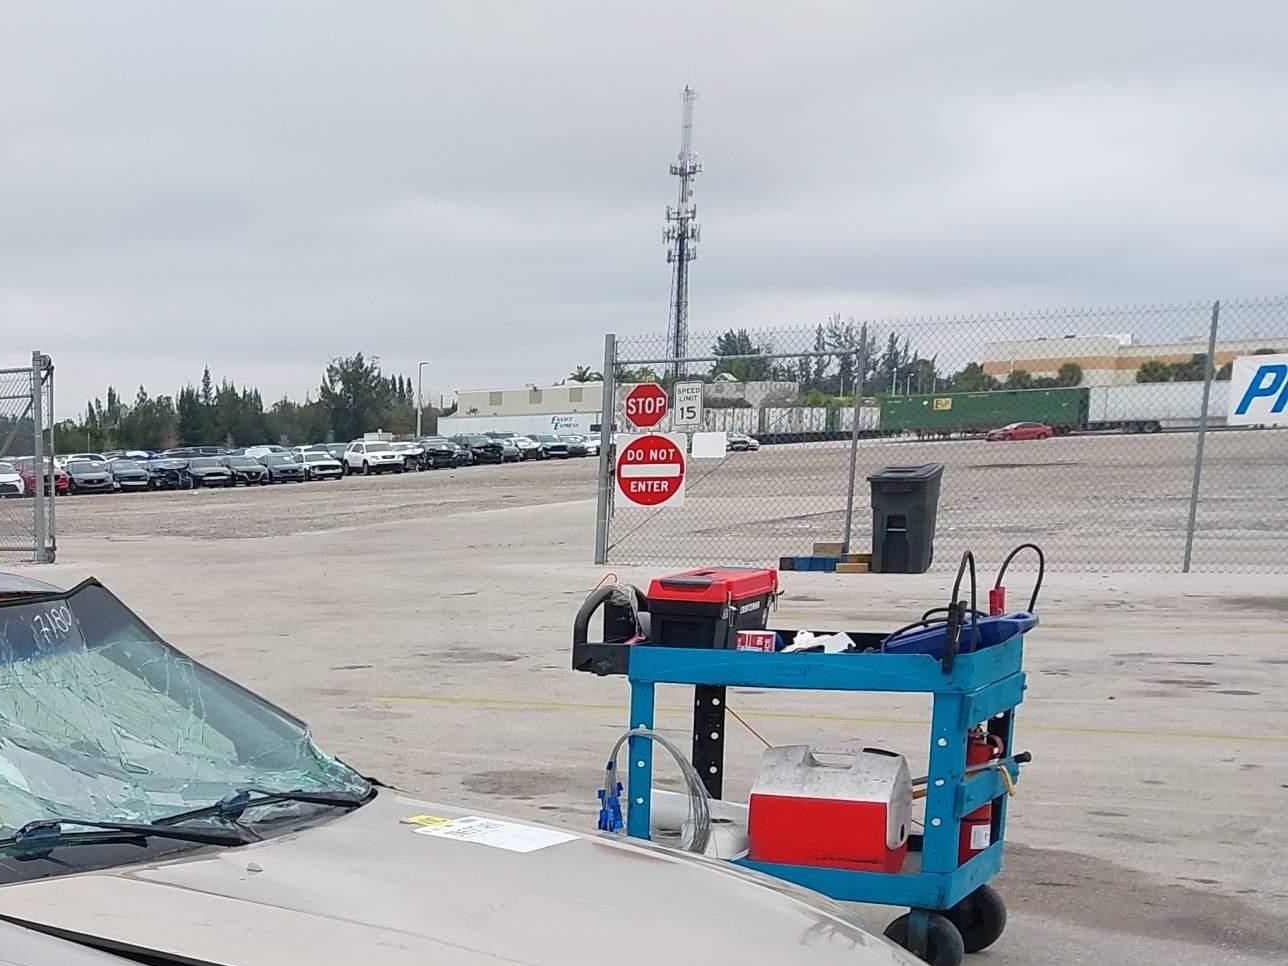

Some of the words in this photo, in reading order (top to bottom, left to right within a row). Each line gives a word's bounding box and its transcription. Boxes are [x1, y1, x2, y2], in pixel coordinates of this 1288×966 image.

[677, 387, 701, 395] SPEED
[1233, 363, 1288, 415] P
[679, 394, 697, 402] LIMIT
[627, 396, 666, 415] STOP
[679, 406, 697, 420] 15
[626, 449, 645, 461] DO
[649, 448, 676, 461] NOT
[630, 481, 669, 493] ENTER
